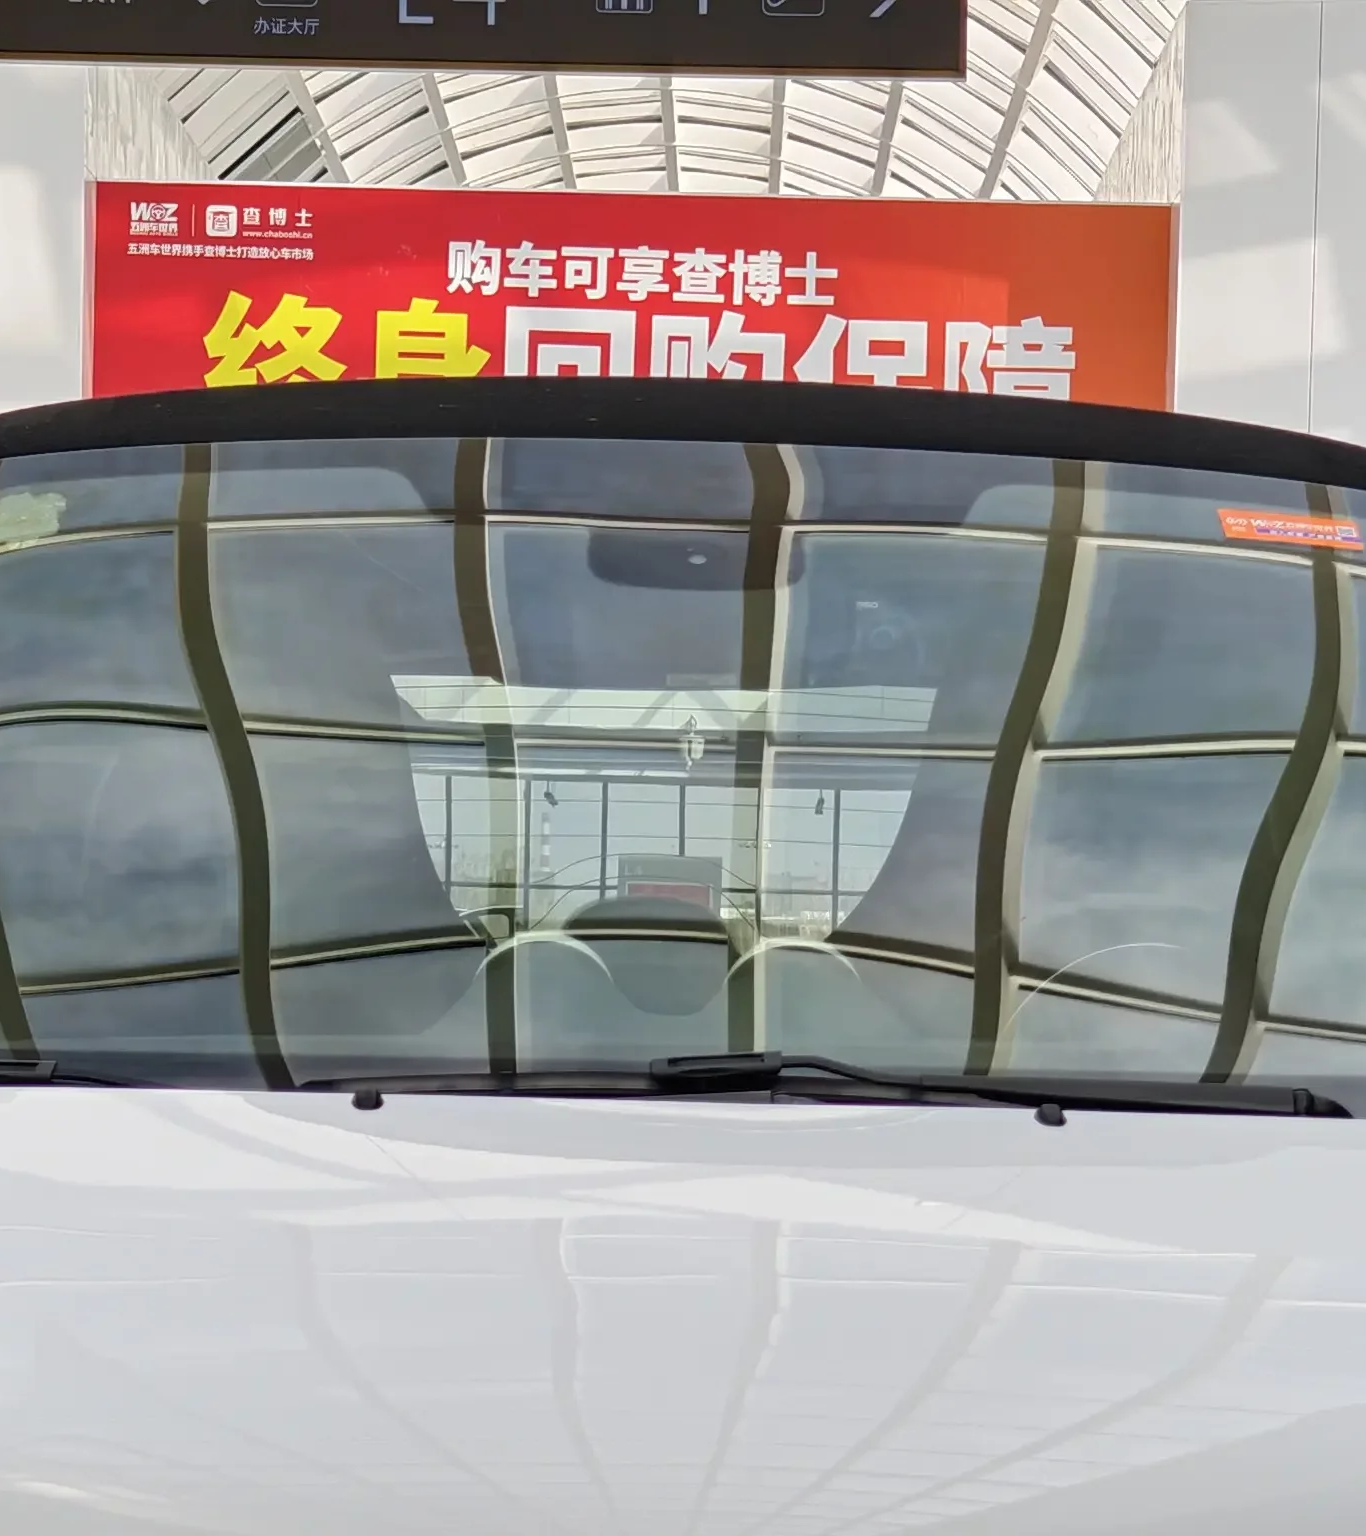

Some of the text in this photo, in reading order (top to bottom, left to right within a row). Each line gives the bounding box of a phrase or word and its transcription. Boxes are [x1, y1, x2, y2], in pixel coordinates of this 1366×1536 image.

[253, 16, 320, 35] 办证大厅
[243, 207, 313, 227] 查博士
[243, 231, 313, 239] www.chaboshi.cn
[127, 243, 314, 261] 五洲车世界携手查博士打造放心车市场
[446, 239, 839, 307] 购车可享查博士
